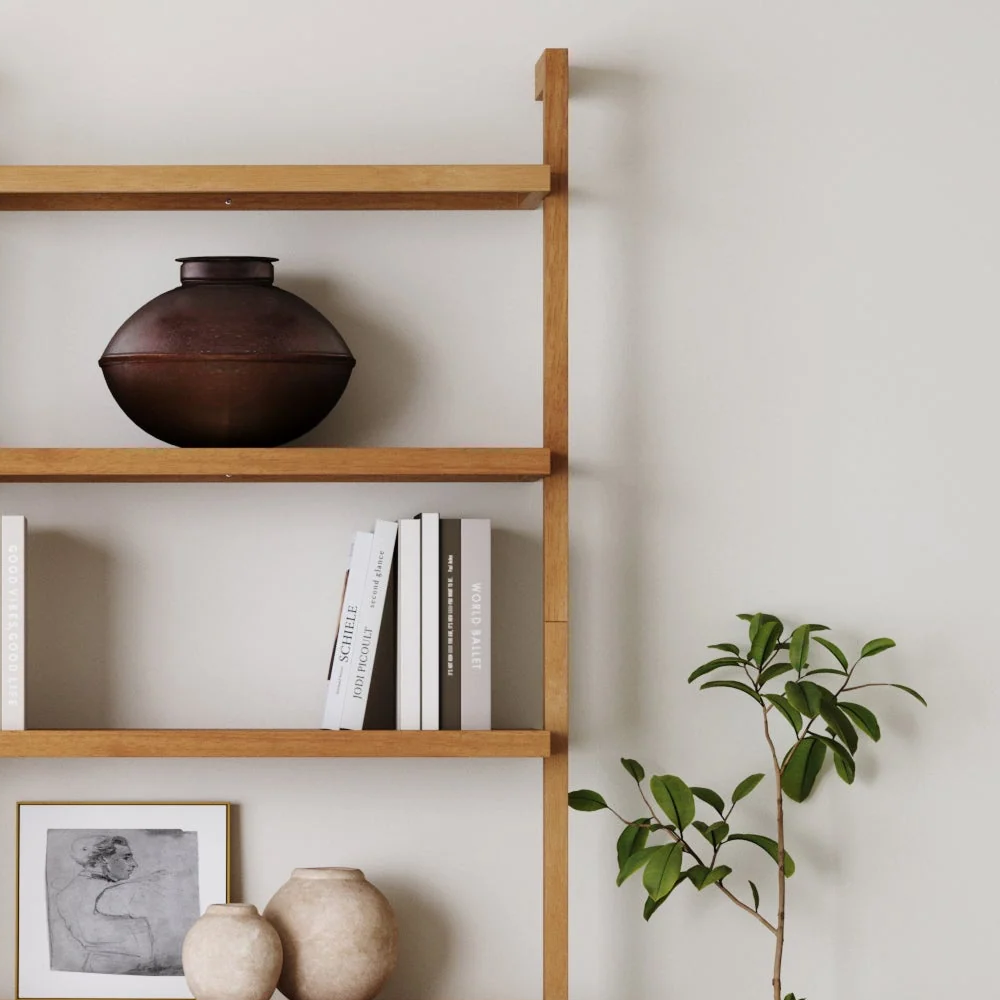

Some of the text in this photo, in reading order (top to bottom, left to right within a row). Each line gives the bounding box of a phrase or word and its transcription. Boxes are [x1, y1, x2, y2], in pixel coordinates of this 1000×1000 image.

[8, 544, 19, 584] GOOD
[339, 604, 358, 663] SCHIELE
[353, 550, 385, 700] JODI PICOULT second glance
[471, 582, 481, 670] WORLD BALLET
